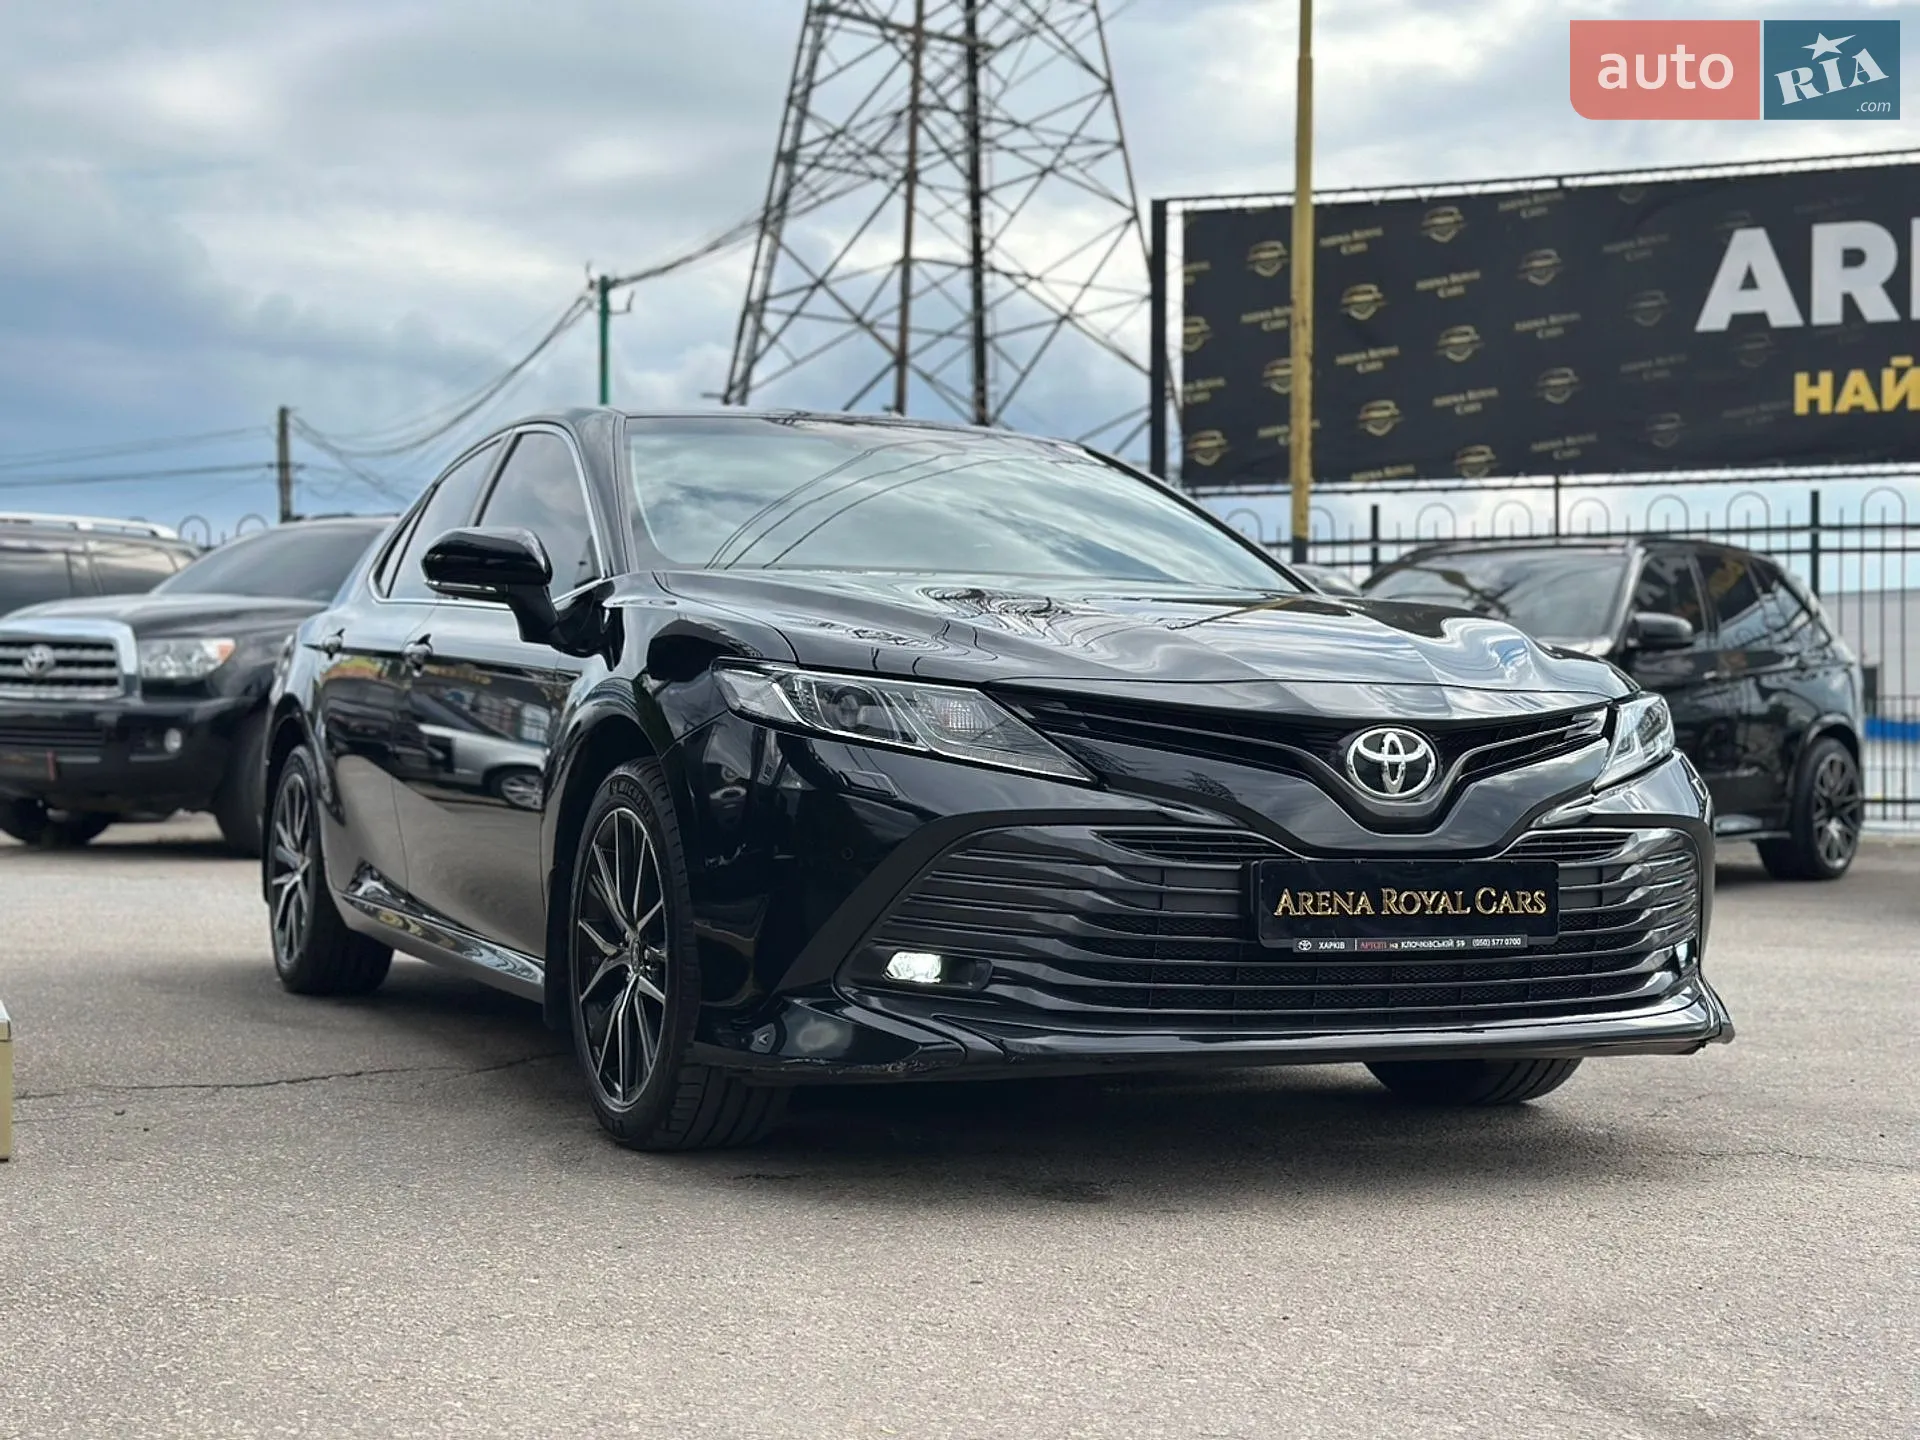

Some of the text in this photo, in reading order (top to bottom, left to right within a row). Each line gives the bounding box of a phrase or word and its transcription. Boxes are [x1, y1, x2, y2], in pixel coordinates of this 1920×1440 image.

[1274, 886, 1547, 916] ARENA ROYAL CARS
